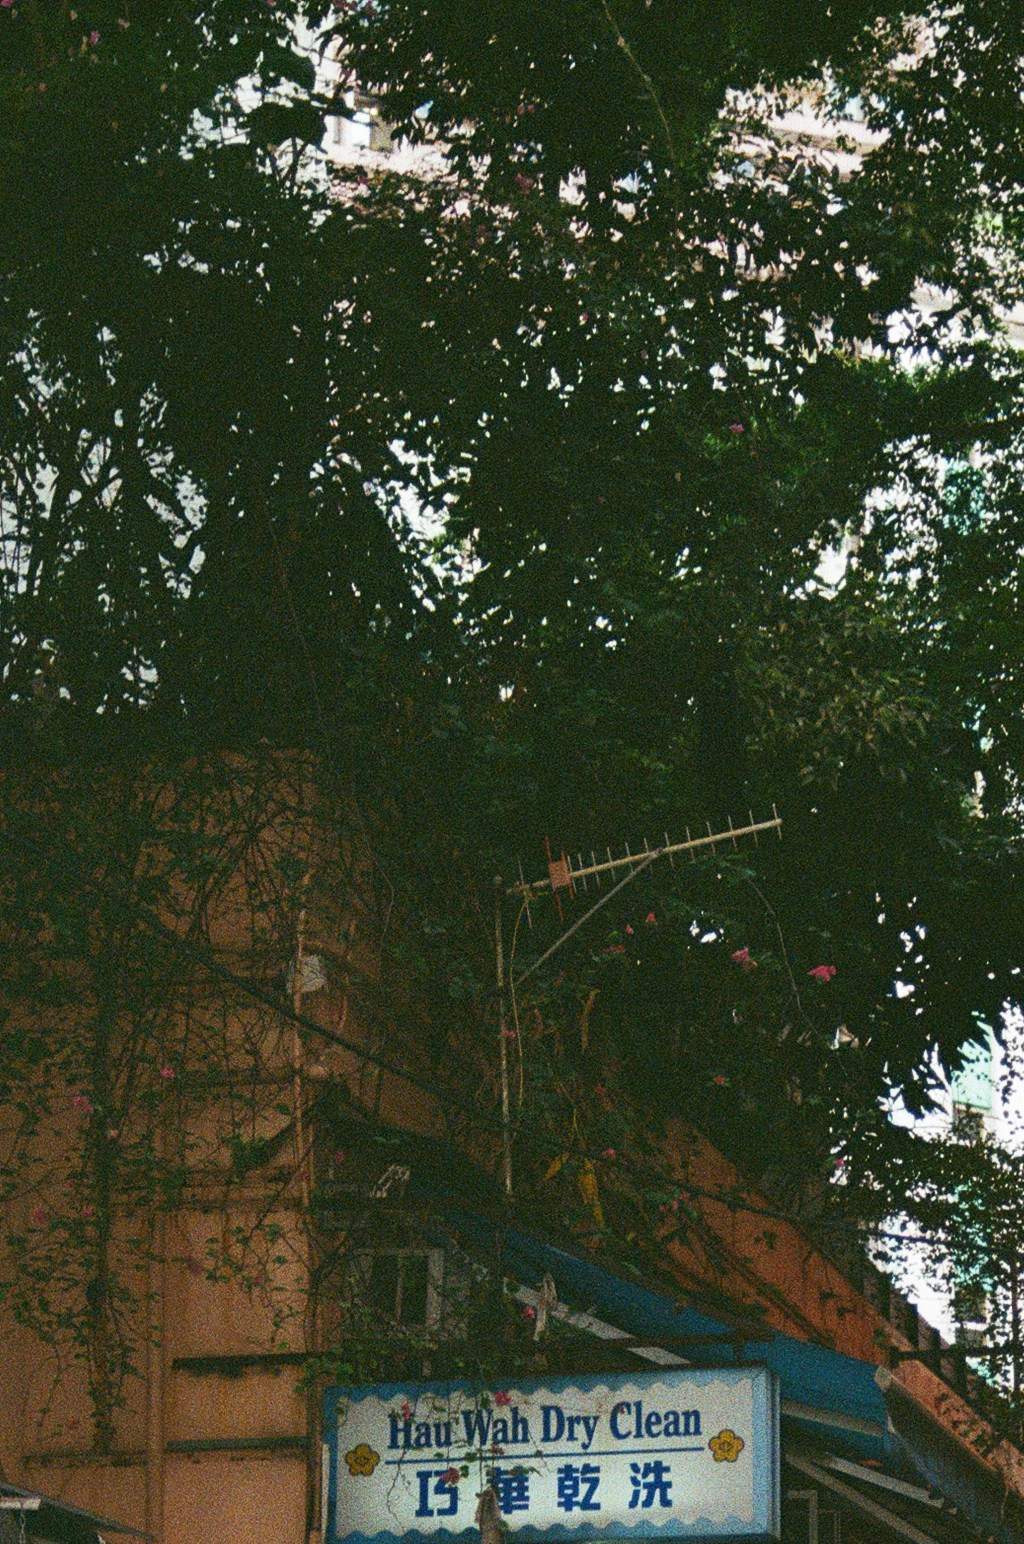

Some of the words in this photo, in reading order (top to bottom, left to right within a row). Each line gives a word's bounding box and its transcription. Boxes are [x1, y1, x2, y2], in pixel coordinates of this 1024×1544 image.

[388, 1413, 453, 1450] Hau
[462, 1405, 530, 1447] Wah
[540, 1403, 600, 1450] Dry
[609, 1400, 703, 1441] Clean
[415, 1460, 674, 1518] 巧華乾洗
